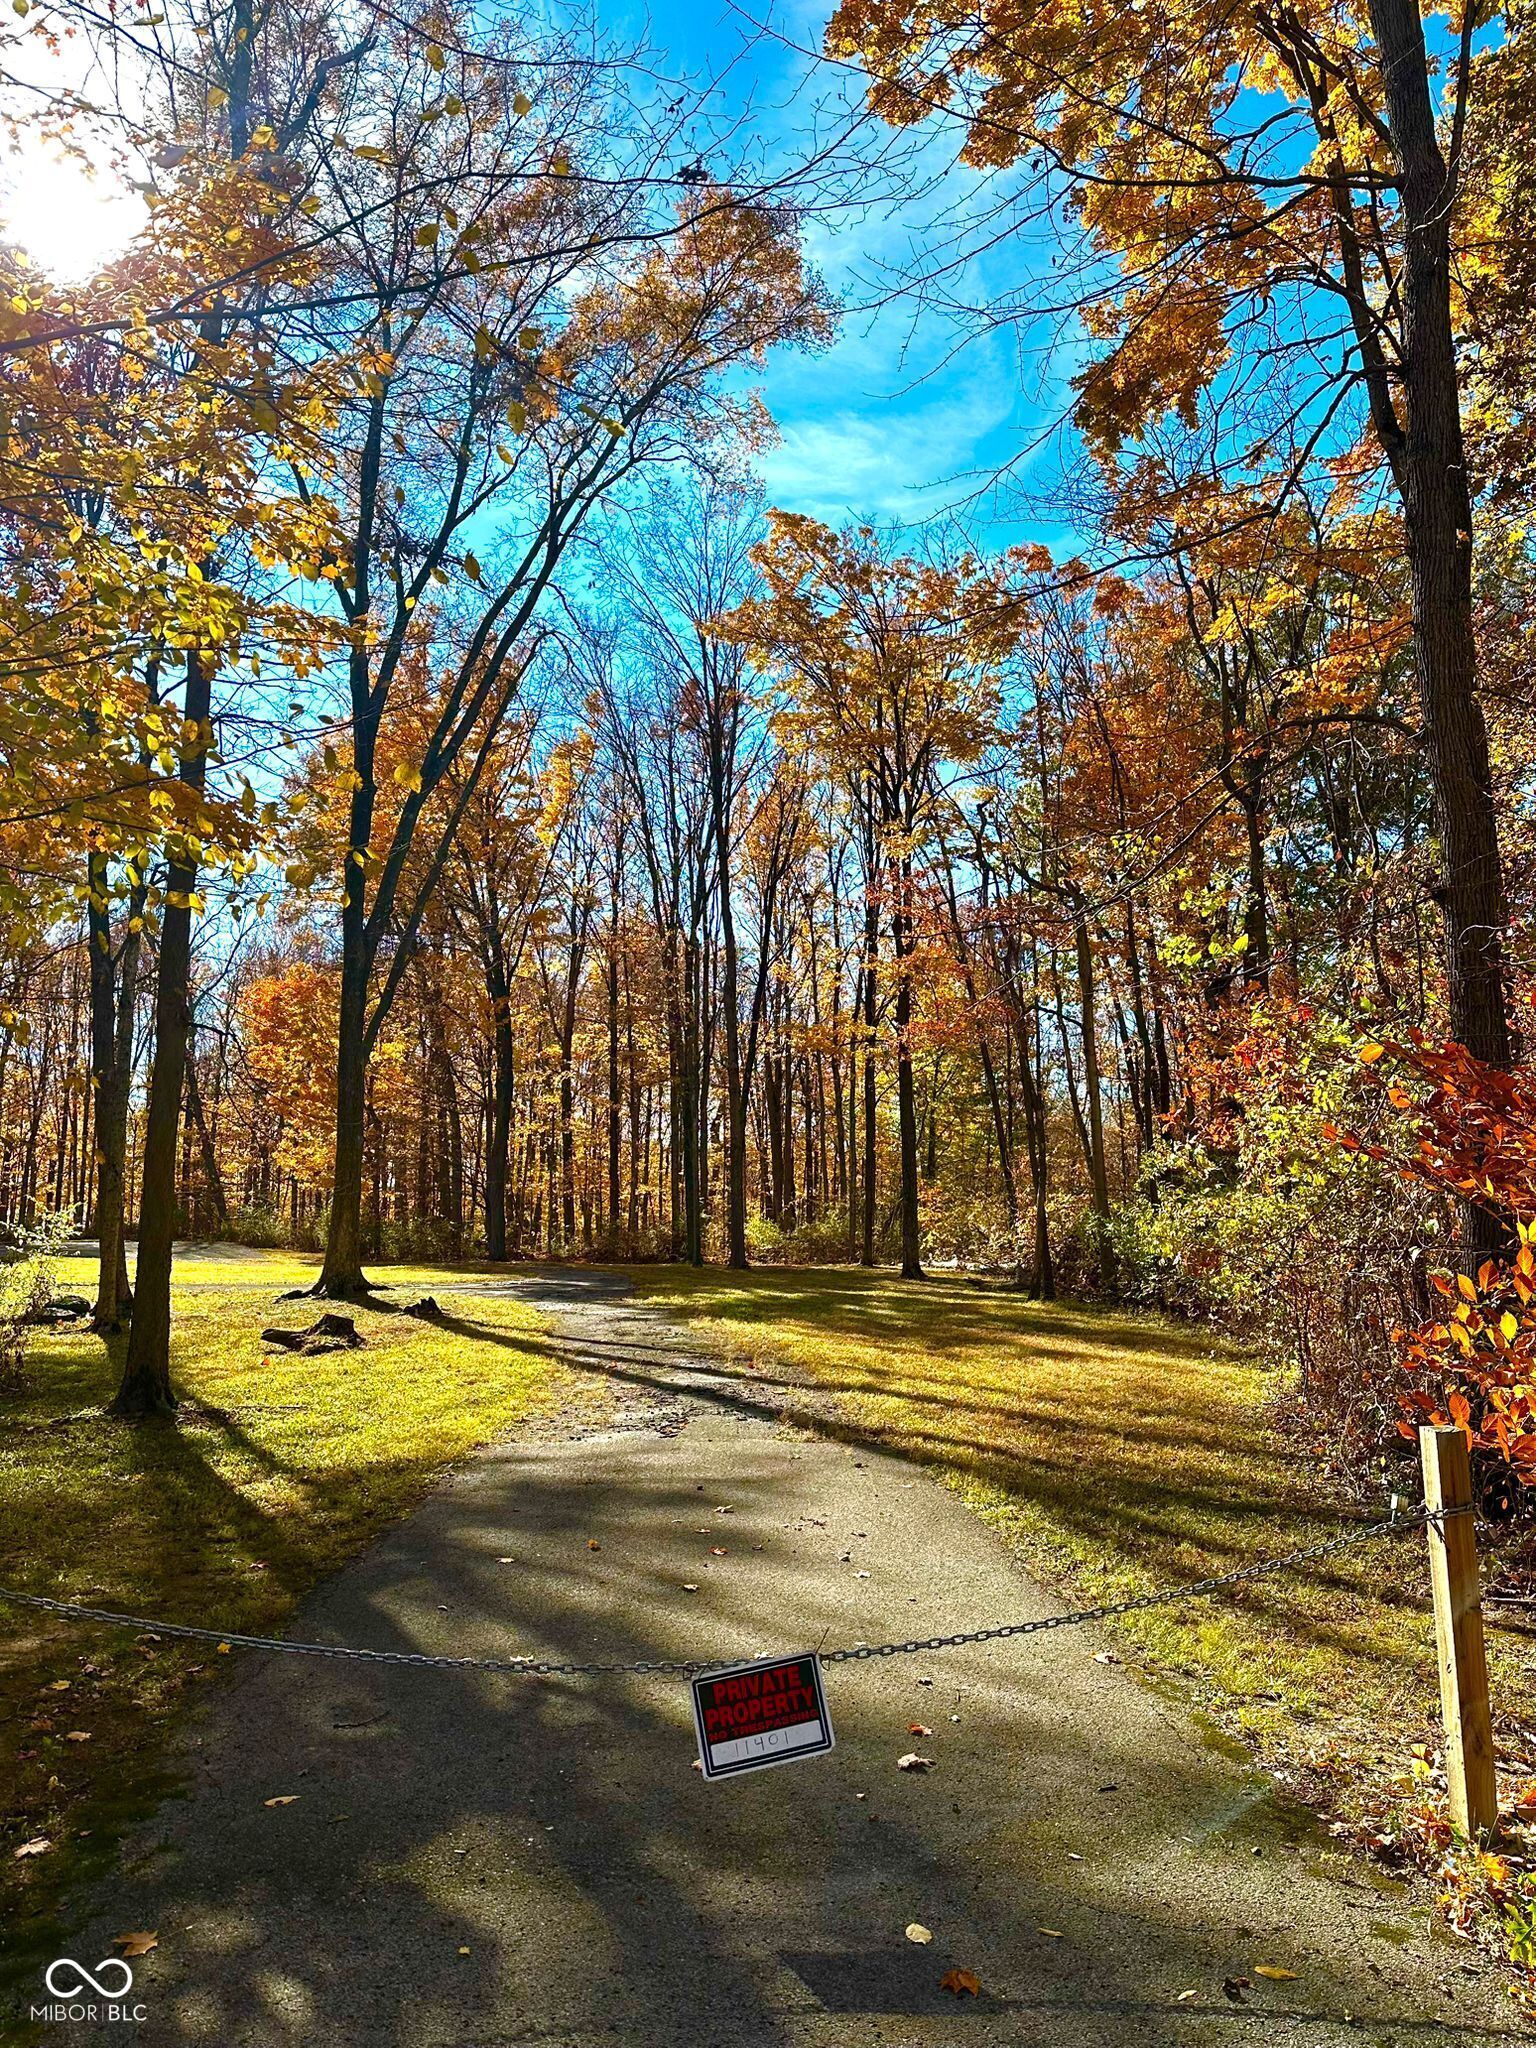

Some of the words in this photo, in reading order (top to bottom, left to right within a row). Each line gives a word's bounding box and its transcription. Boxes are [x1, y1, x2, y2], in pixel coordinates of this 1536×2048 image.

[712, 1666, 802, 1705] PRIVATE
[704, 1685, 814, 1731] PROPERTY
[708, 1731, 728, 1742] NO
[735, 1731, 789, 1757] 11401
